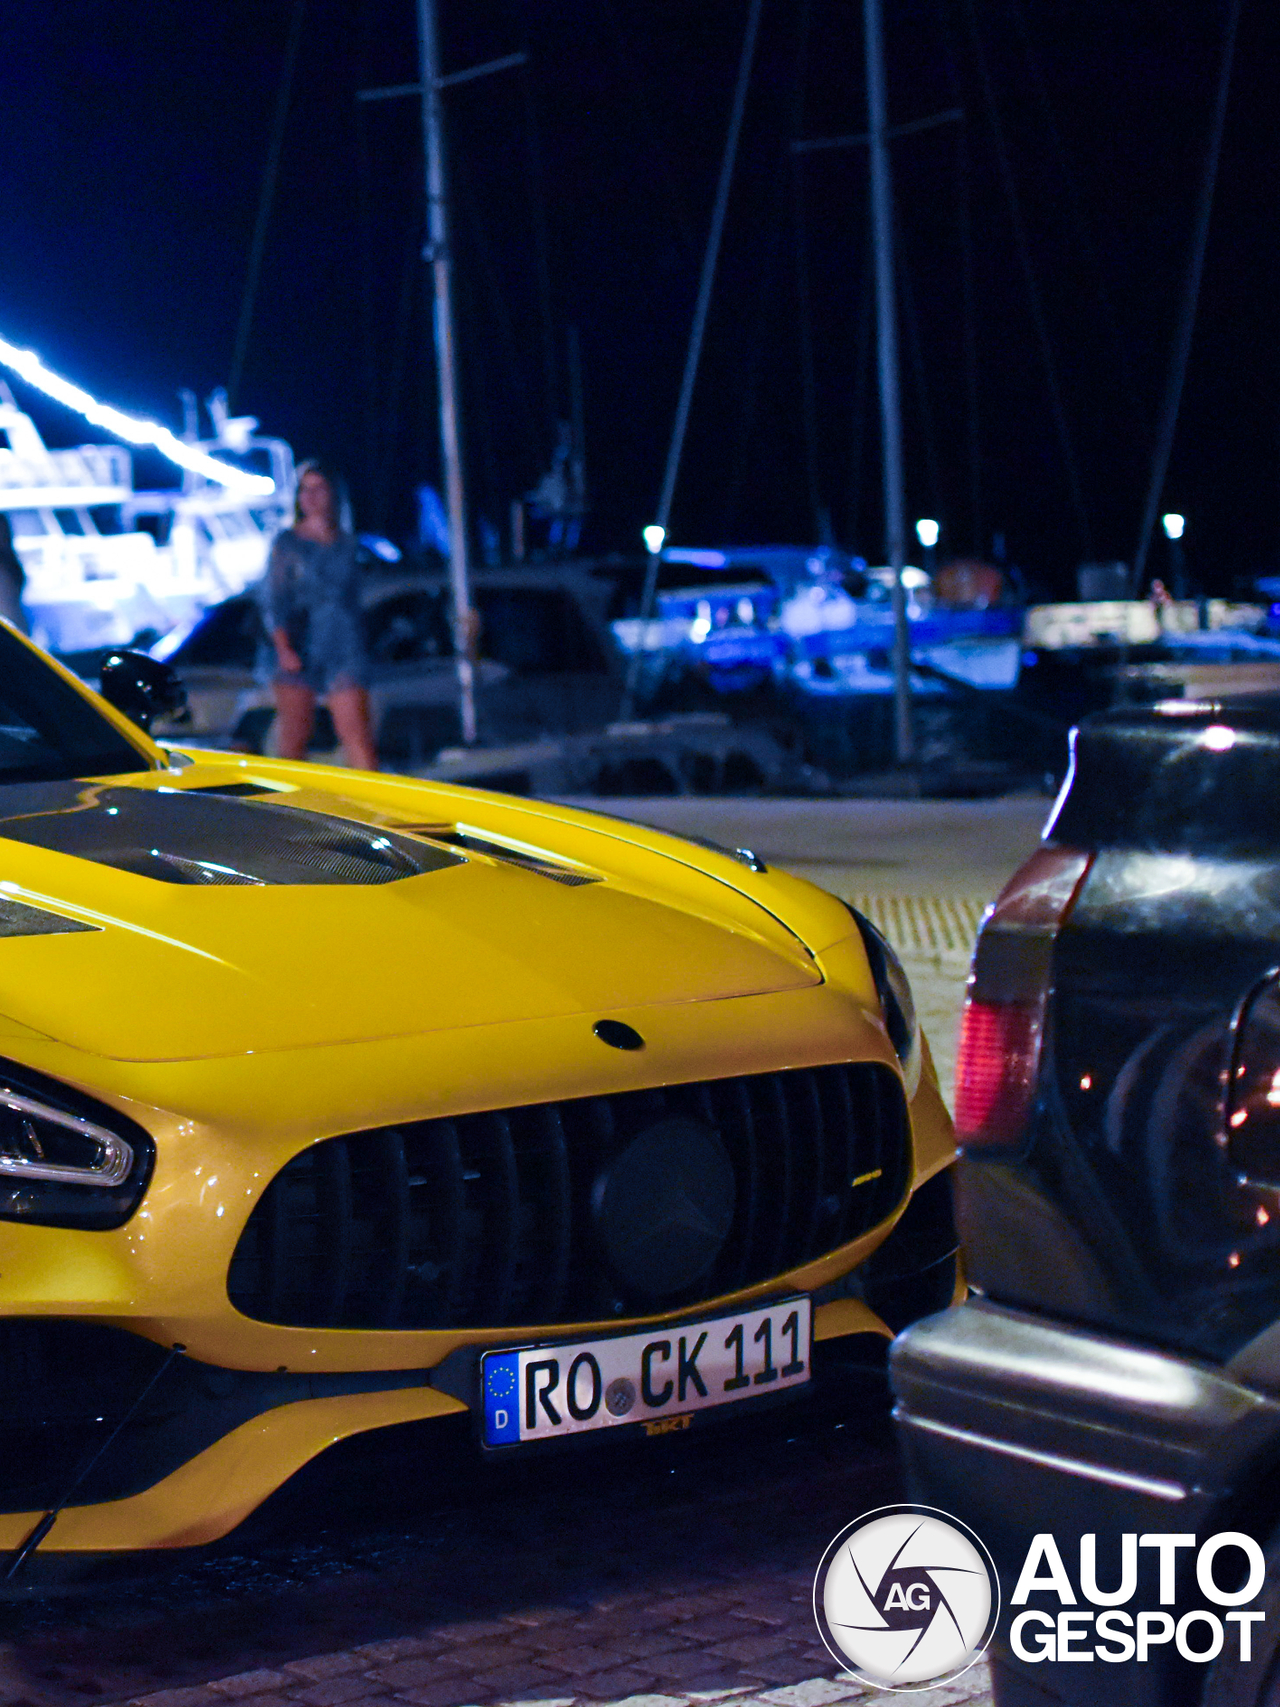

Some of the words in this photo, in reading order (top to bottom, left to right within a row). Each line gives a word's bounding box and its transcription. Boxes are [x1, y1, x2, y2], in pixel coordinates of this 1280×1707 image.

[525, 1352, 602, 1430] RO
[641, 1331, 708, 1408] CK
[723, 1311, 805, 1392] 111
[495, 1410, 508, 1429] D
